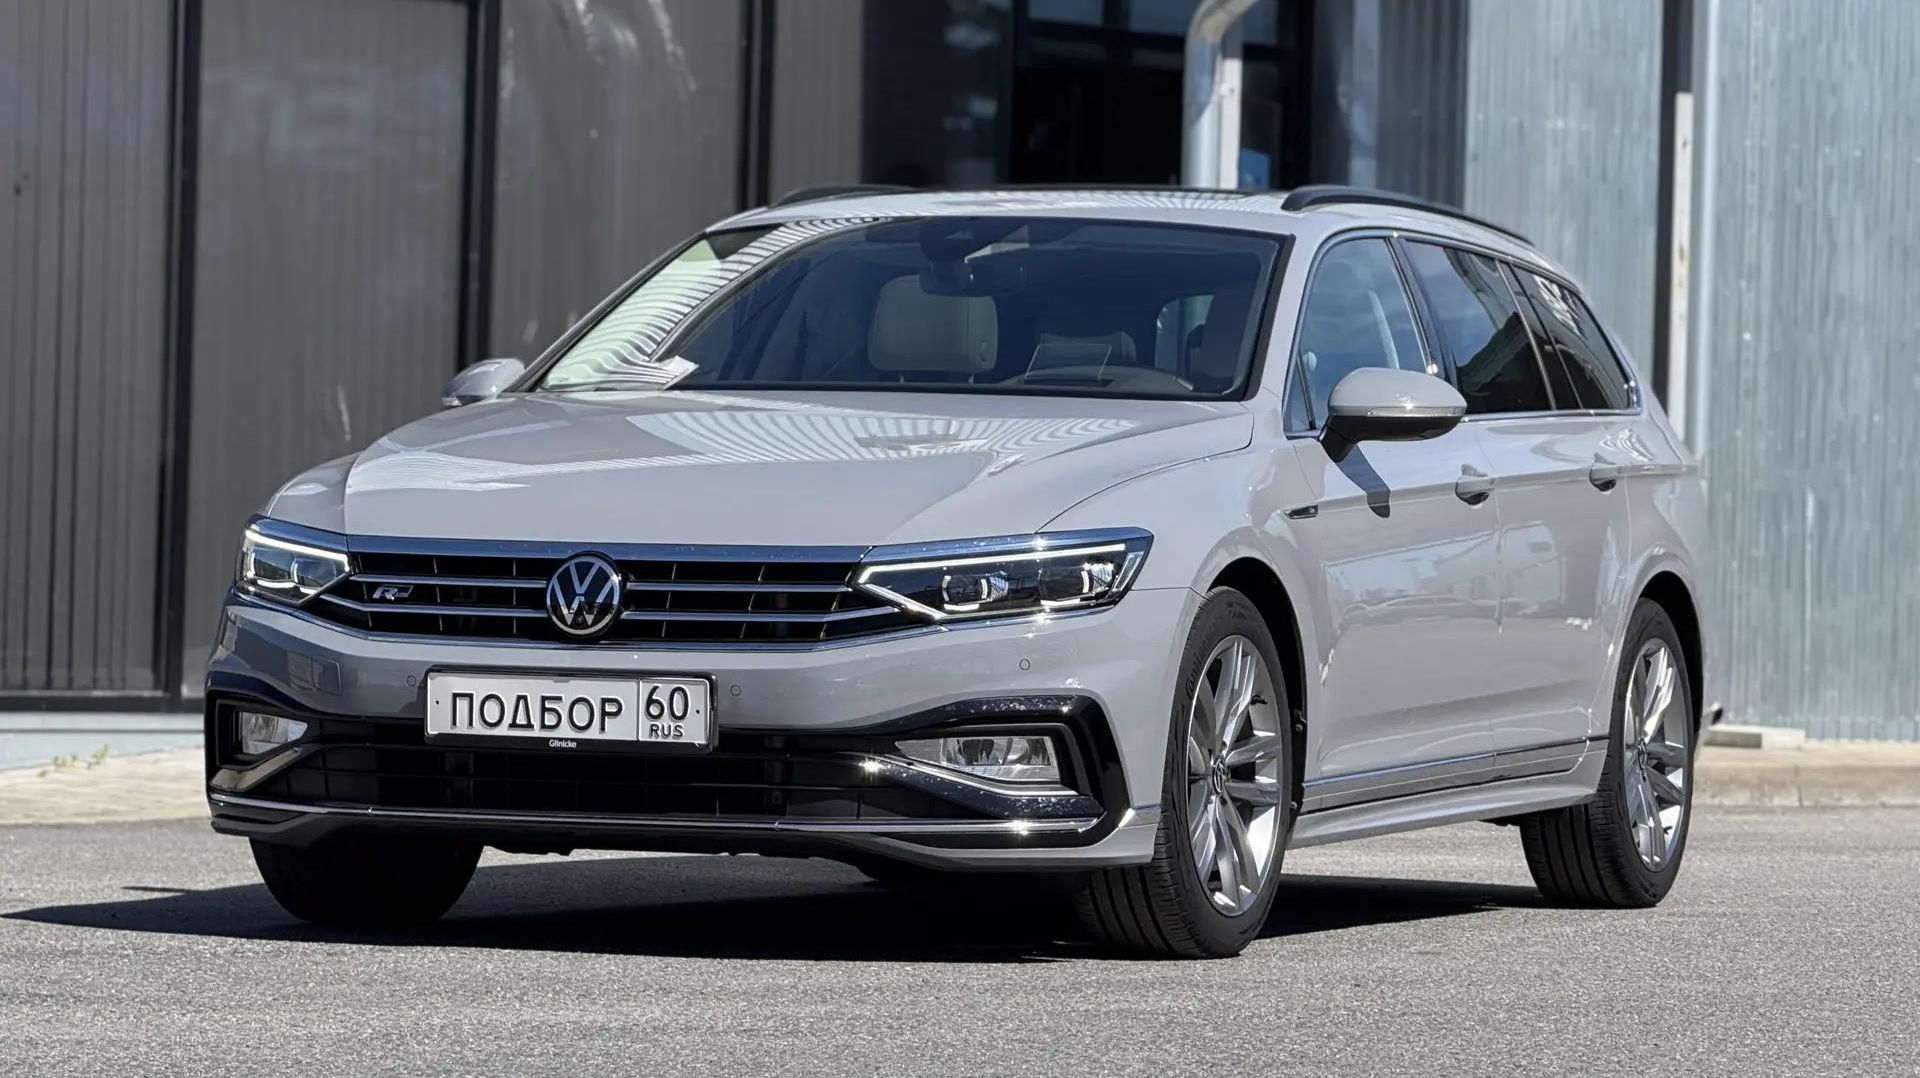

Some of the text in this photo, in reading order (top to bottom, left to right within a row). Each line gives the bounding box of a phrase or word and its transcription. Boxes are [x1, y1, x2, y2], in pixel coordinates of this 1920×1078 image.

[451, 685, 689, 732] ПОДБОР 60
[649, 723, 684, 739] RUS
